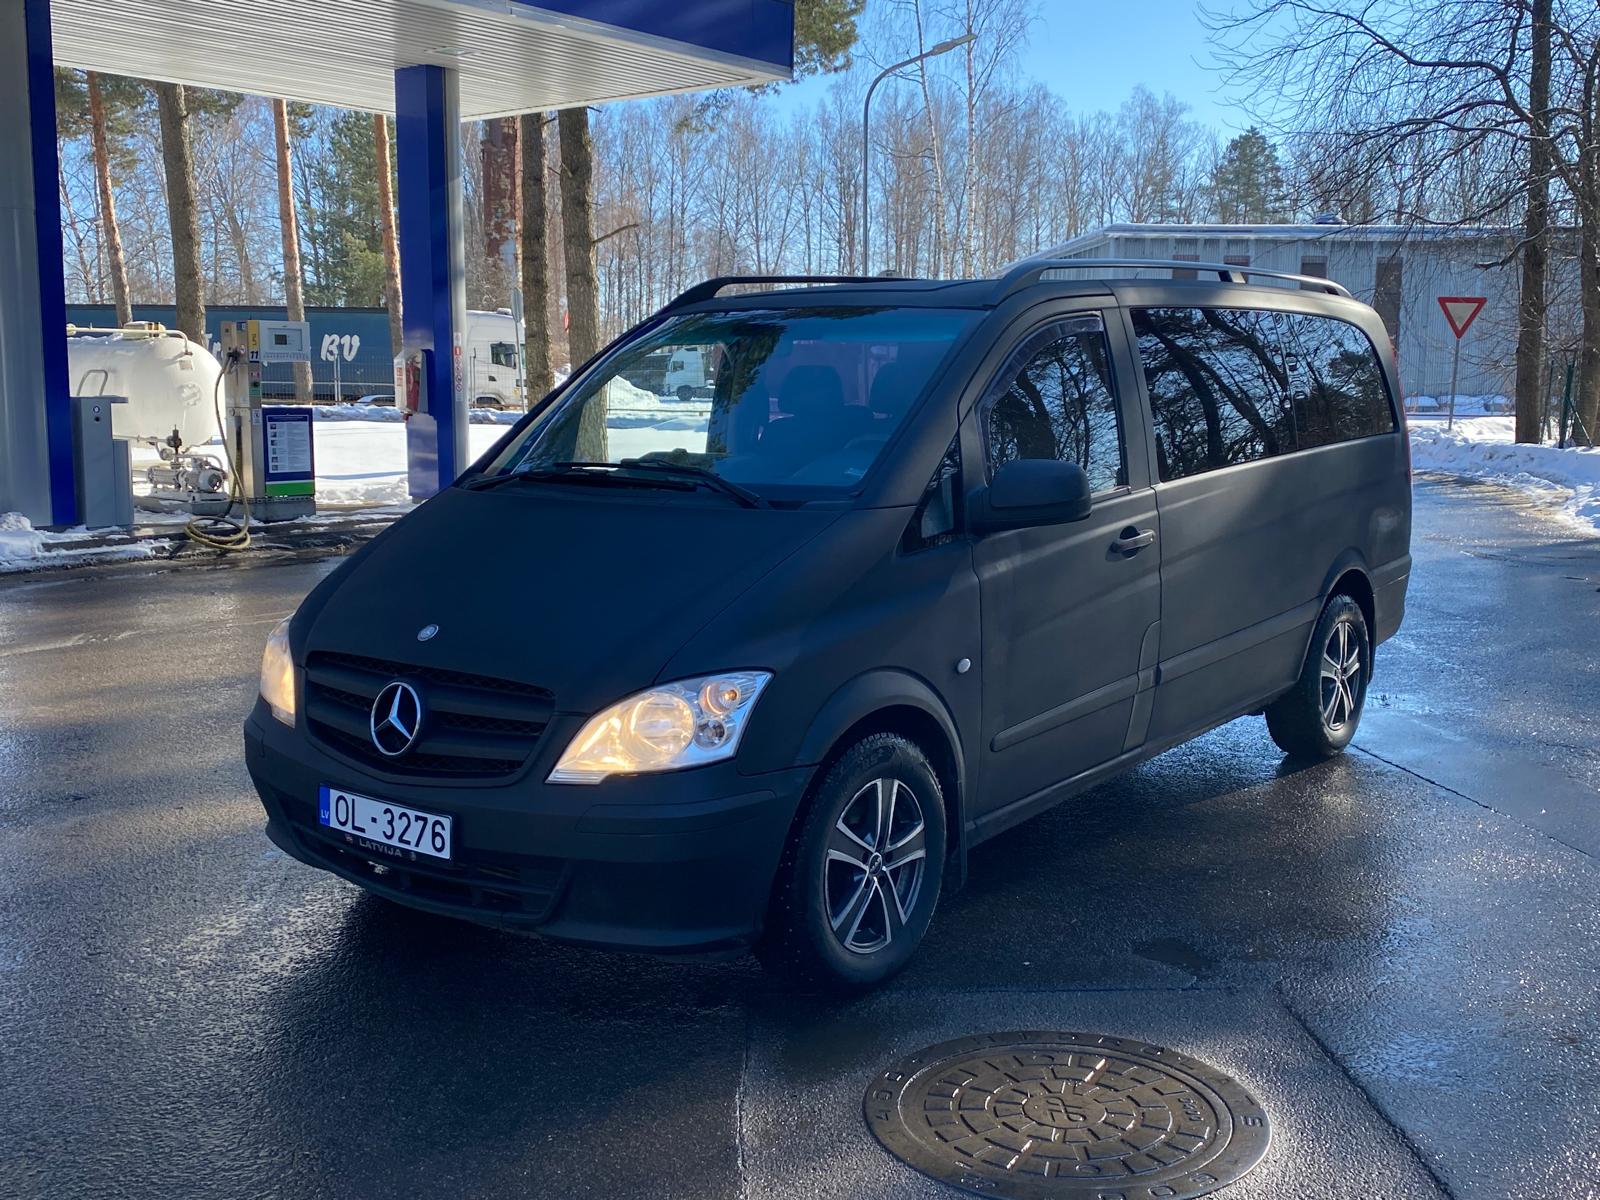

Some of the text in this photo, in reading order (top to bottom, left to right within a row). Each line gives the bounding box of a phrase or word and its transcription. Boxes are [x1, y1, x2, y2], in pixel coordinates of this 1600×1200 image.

[250, 351, 259, 360] 11
[321, 333, 360, 362] BV
[320, 808, 330, 820] LV
[335, 794, 446, 853] OL-3276
[358, 838, 403, 858] LATVIJA
